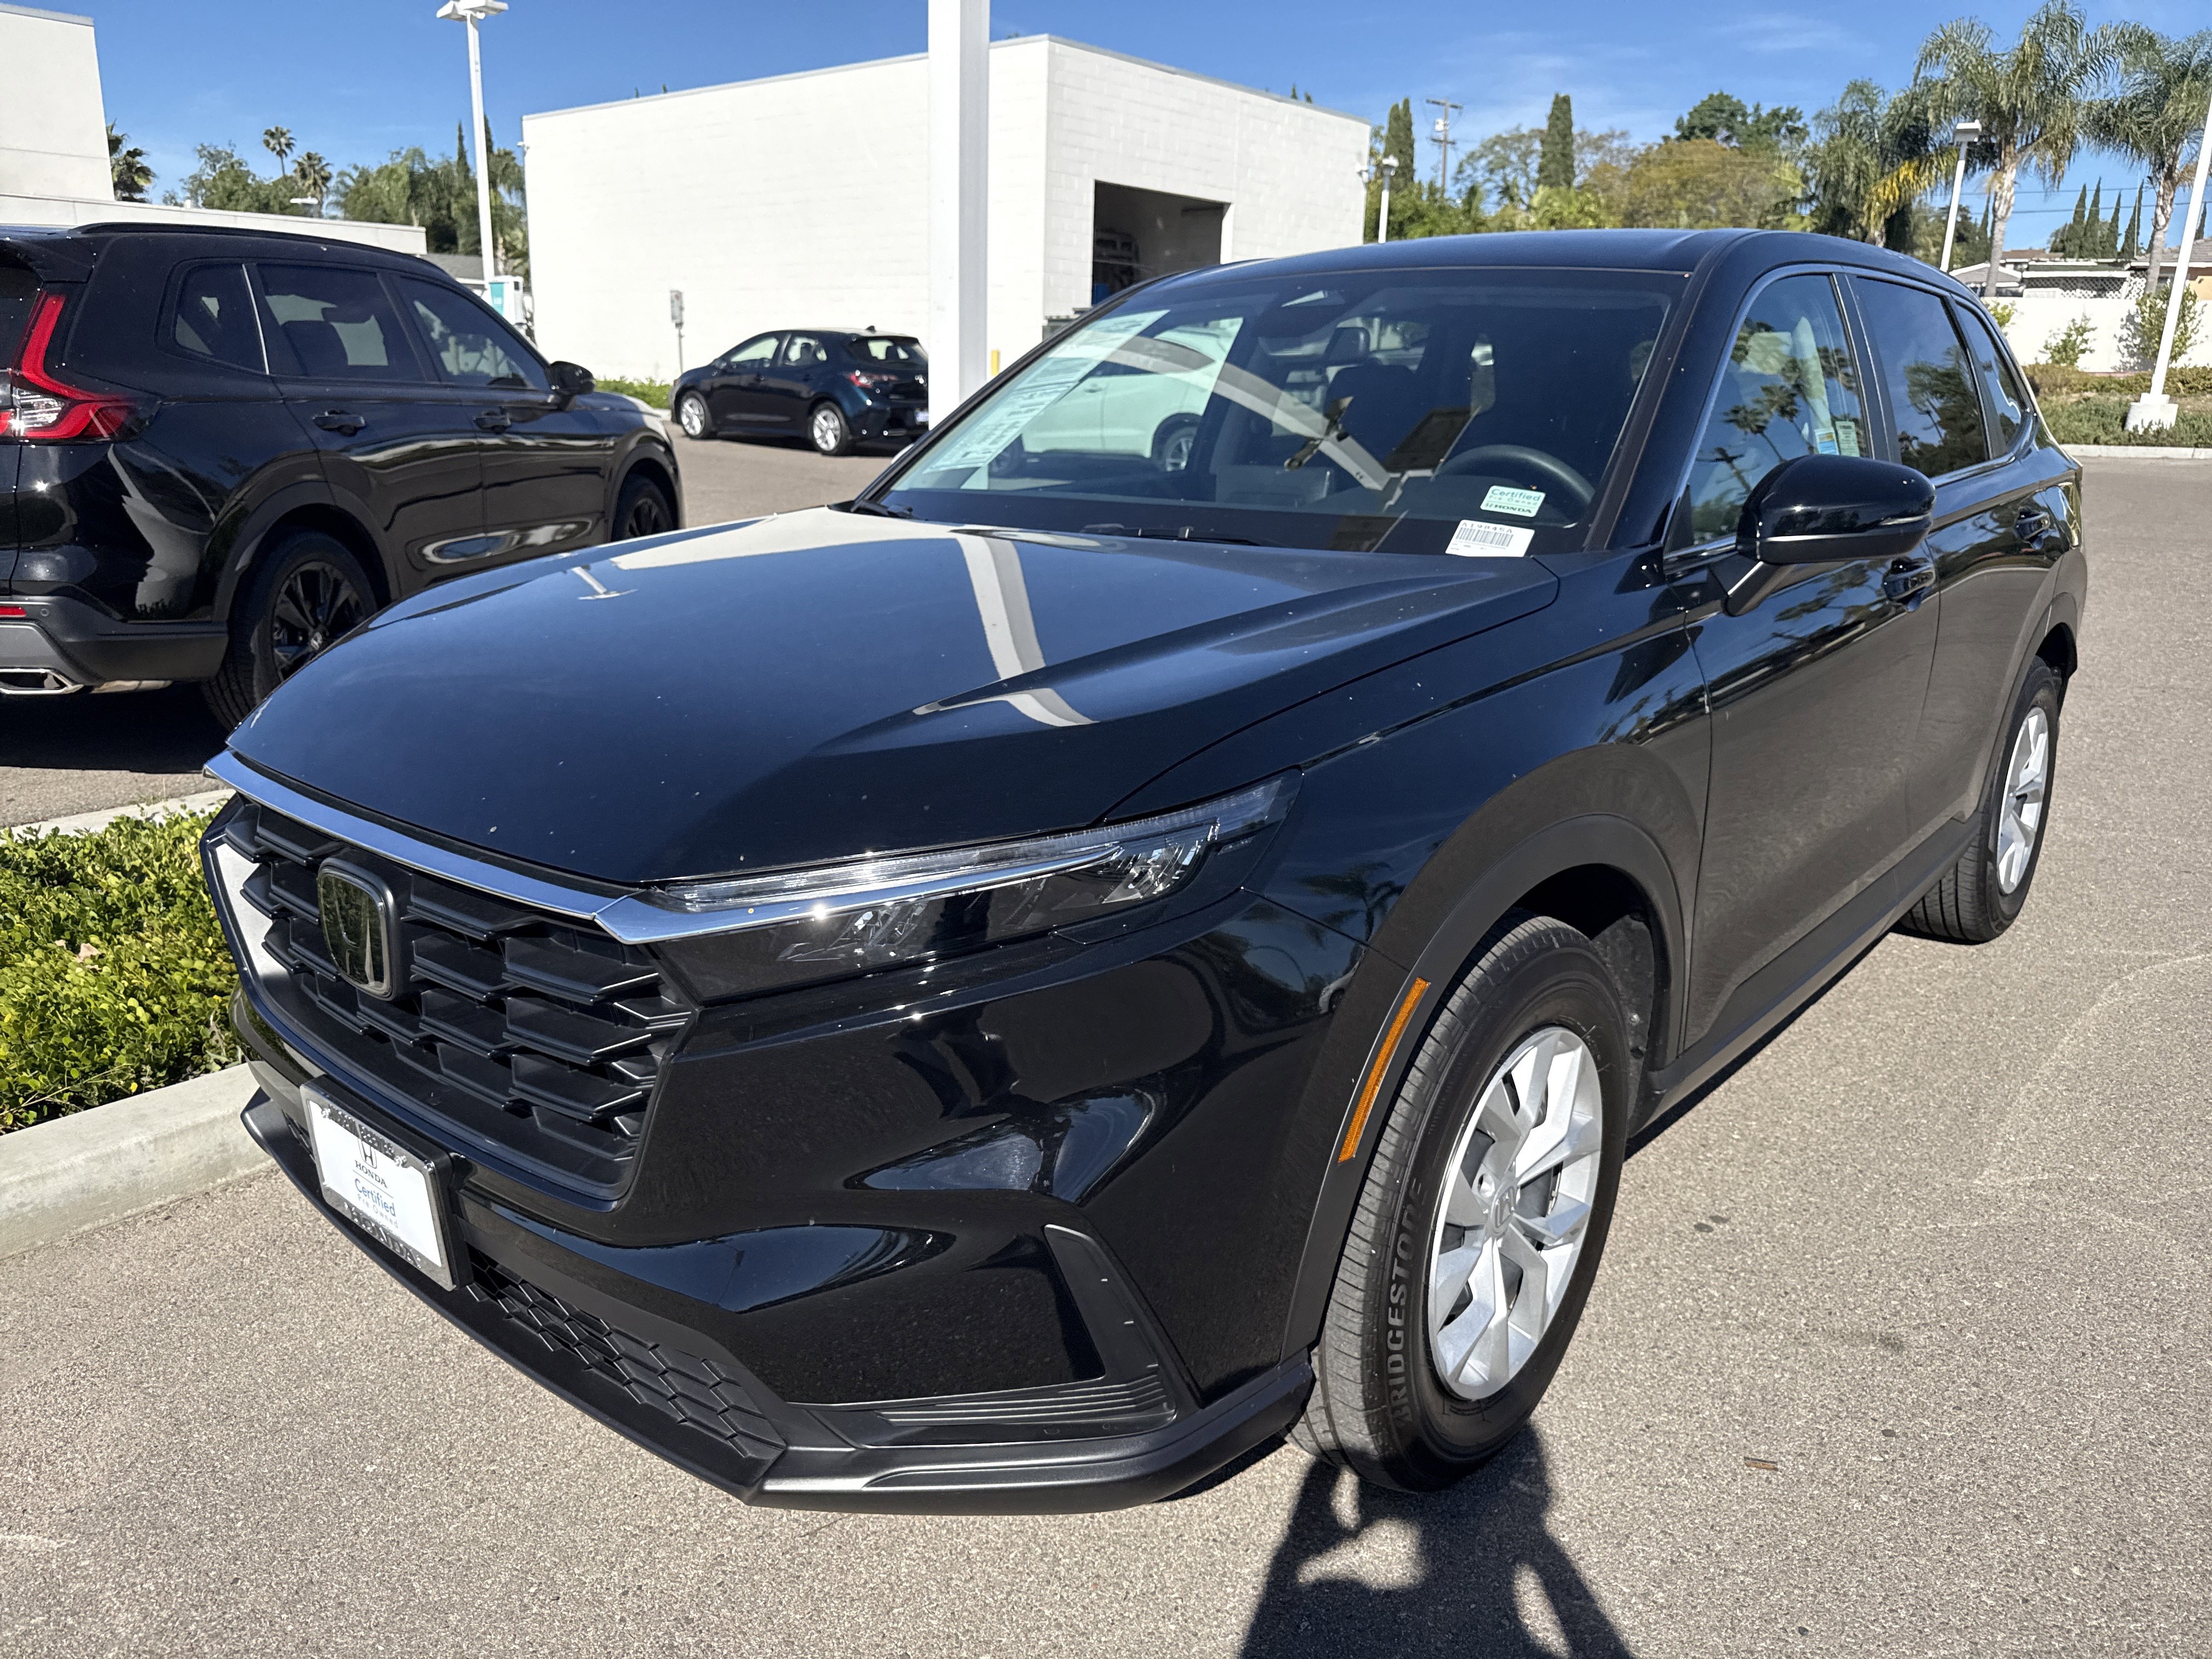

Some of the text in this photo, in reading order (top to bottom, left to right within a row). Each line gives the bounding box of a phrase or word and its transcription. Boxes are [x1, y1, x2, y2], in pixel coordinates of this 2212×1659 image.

[1491, 489, 1541, 501] Certified
[1494, 505, 1532, 514] HONDA
[354, 1160, 388, 1189] HONDA
[354, 1178, 396, 1217] Certified
[1387, 1176, 1424, 1423] BRIDGESTONE
